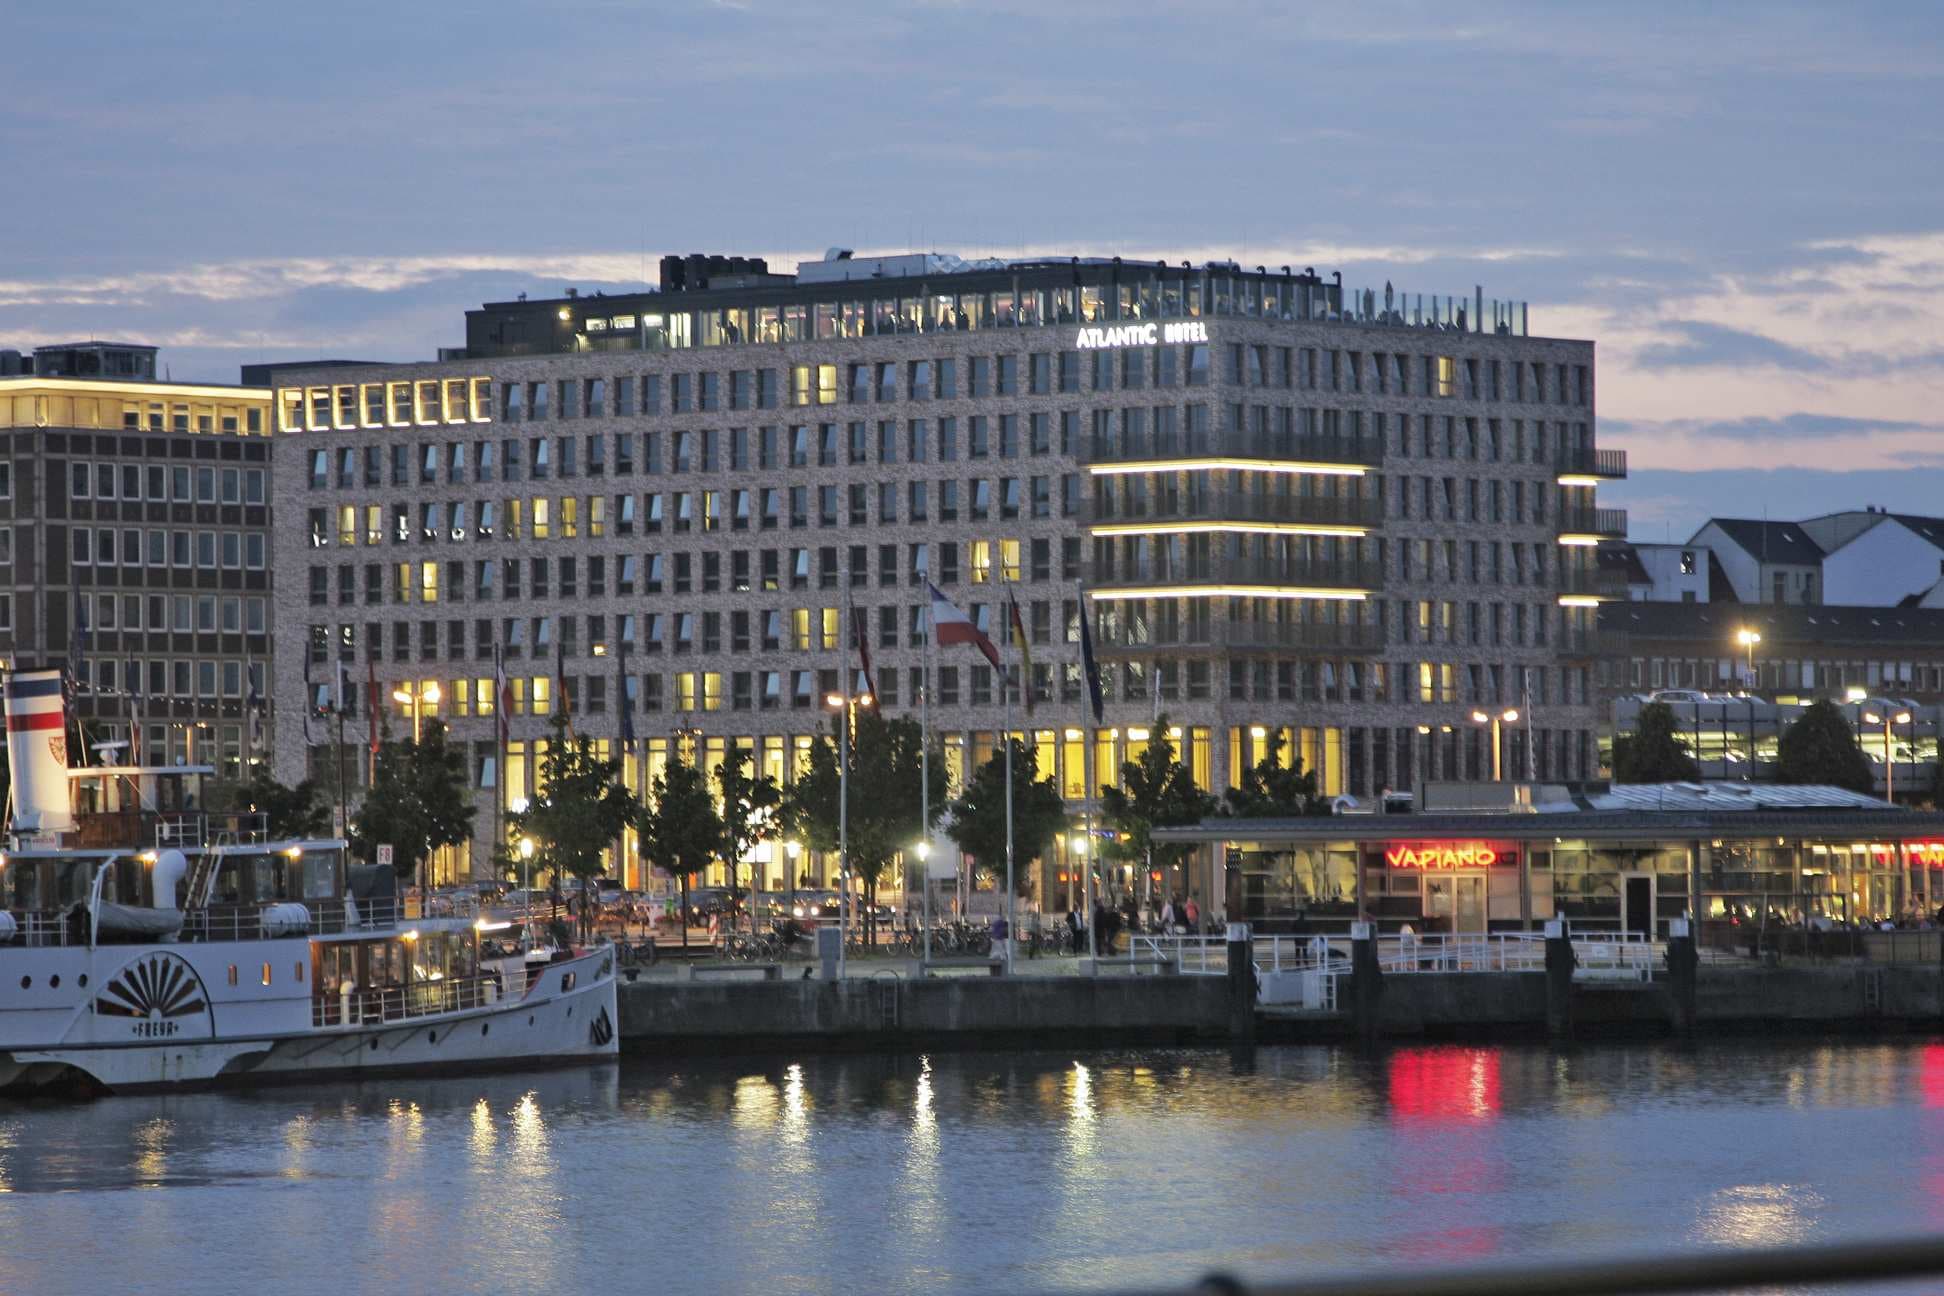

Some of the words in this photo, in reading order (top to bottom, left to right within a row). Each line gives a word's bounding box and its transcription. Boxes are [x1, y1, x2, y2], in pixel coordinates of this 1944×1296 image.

[1076, 323, 1157, 348] ATLANTIC
[1164, 322, 1208, 343] HOTEL
[1387, 846, 1496, 870] VAPIANO
[138, 1021, 173, 1038] FREYA
